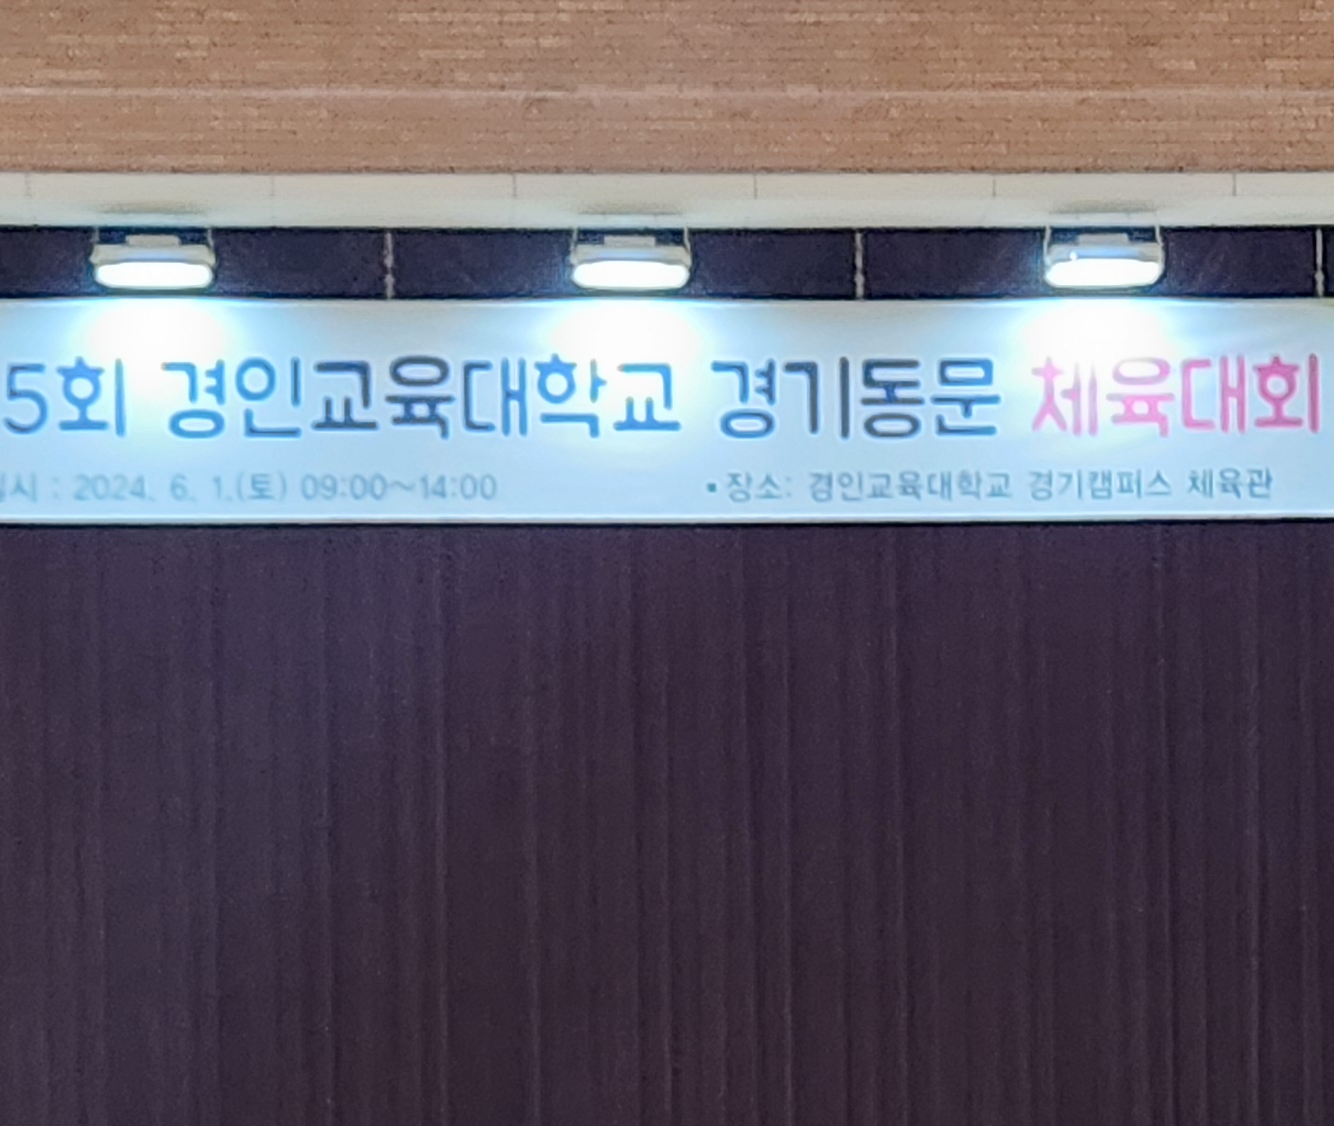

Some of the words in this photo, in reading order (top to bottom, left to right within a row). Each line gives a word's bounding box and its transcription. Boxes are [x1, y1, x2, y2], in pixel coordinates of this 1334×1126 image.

[161, 354, 683, 440] 경인교육대학교
[710, 355, 1001, 440] 경기동문
[1030, 352, 1322, 438] 체육대회
[73, 474, 156, 502] 2024.
[809, 470, 1013, 502] 경인교육대학교
[1029, 469, 1172, 500] 경기캠퍼스
[1187, 467, 1274, 500] 체육관
